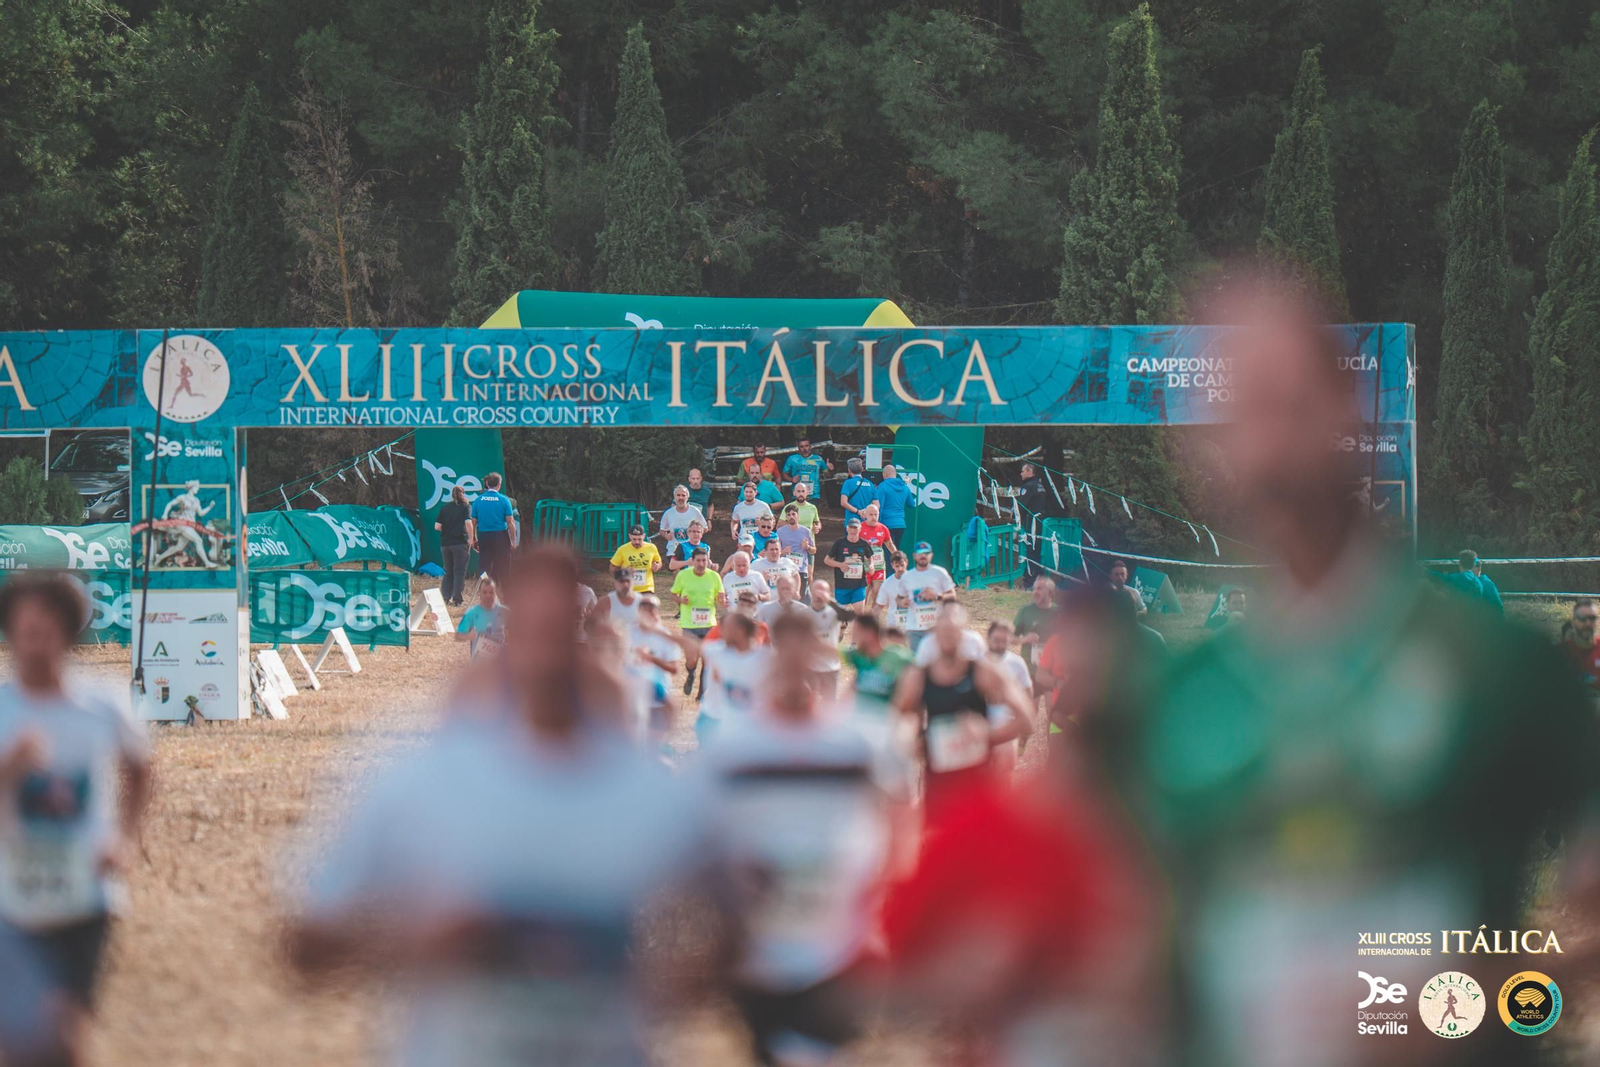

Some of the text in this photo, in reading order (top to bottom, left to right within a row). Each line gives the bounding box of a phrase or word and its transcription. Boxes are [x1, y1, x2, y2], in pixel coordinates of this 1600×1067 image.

[279, 343, 602, 403] XLIII CROSS
[666, 327, 1009, 407] ITÁLICA
[1127, 357, 1233, 373] CAMPEONAT
[1167, 373, 1236, 388] DE CAM
[463, 382, 654, 402] INTERNACIONAL
[279, 405, 619, 425] INTERNATIONAL CROSS COUNTRY
[184, 446, 223, 457] Sevilla
